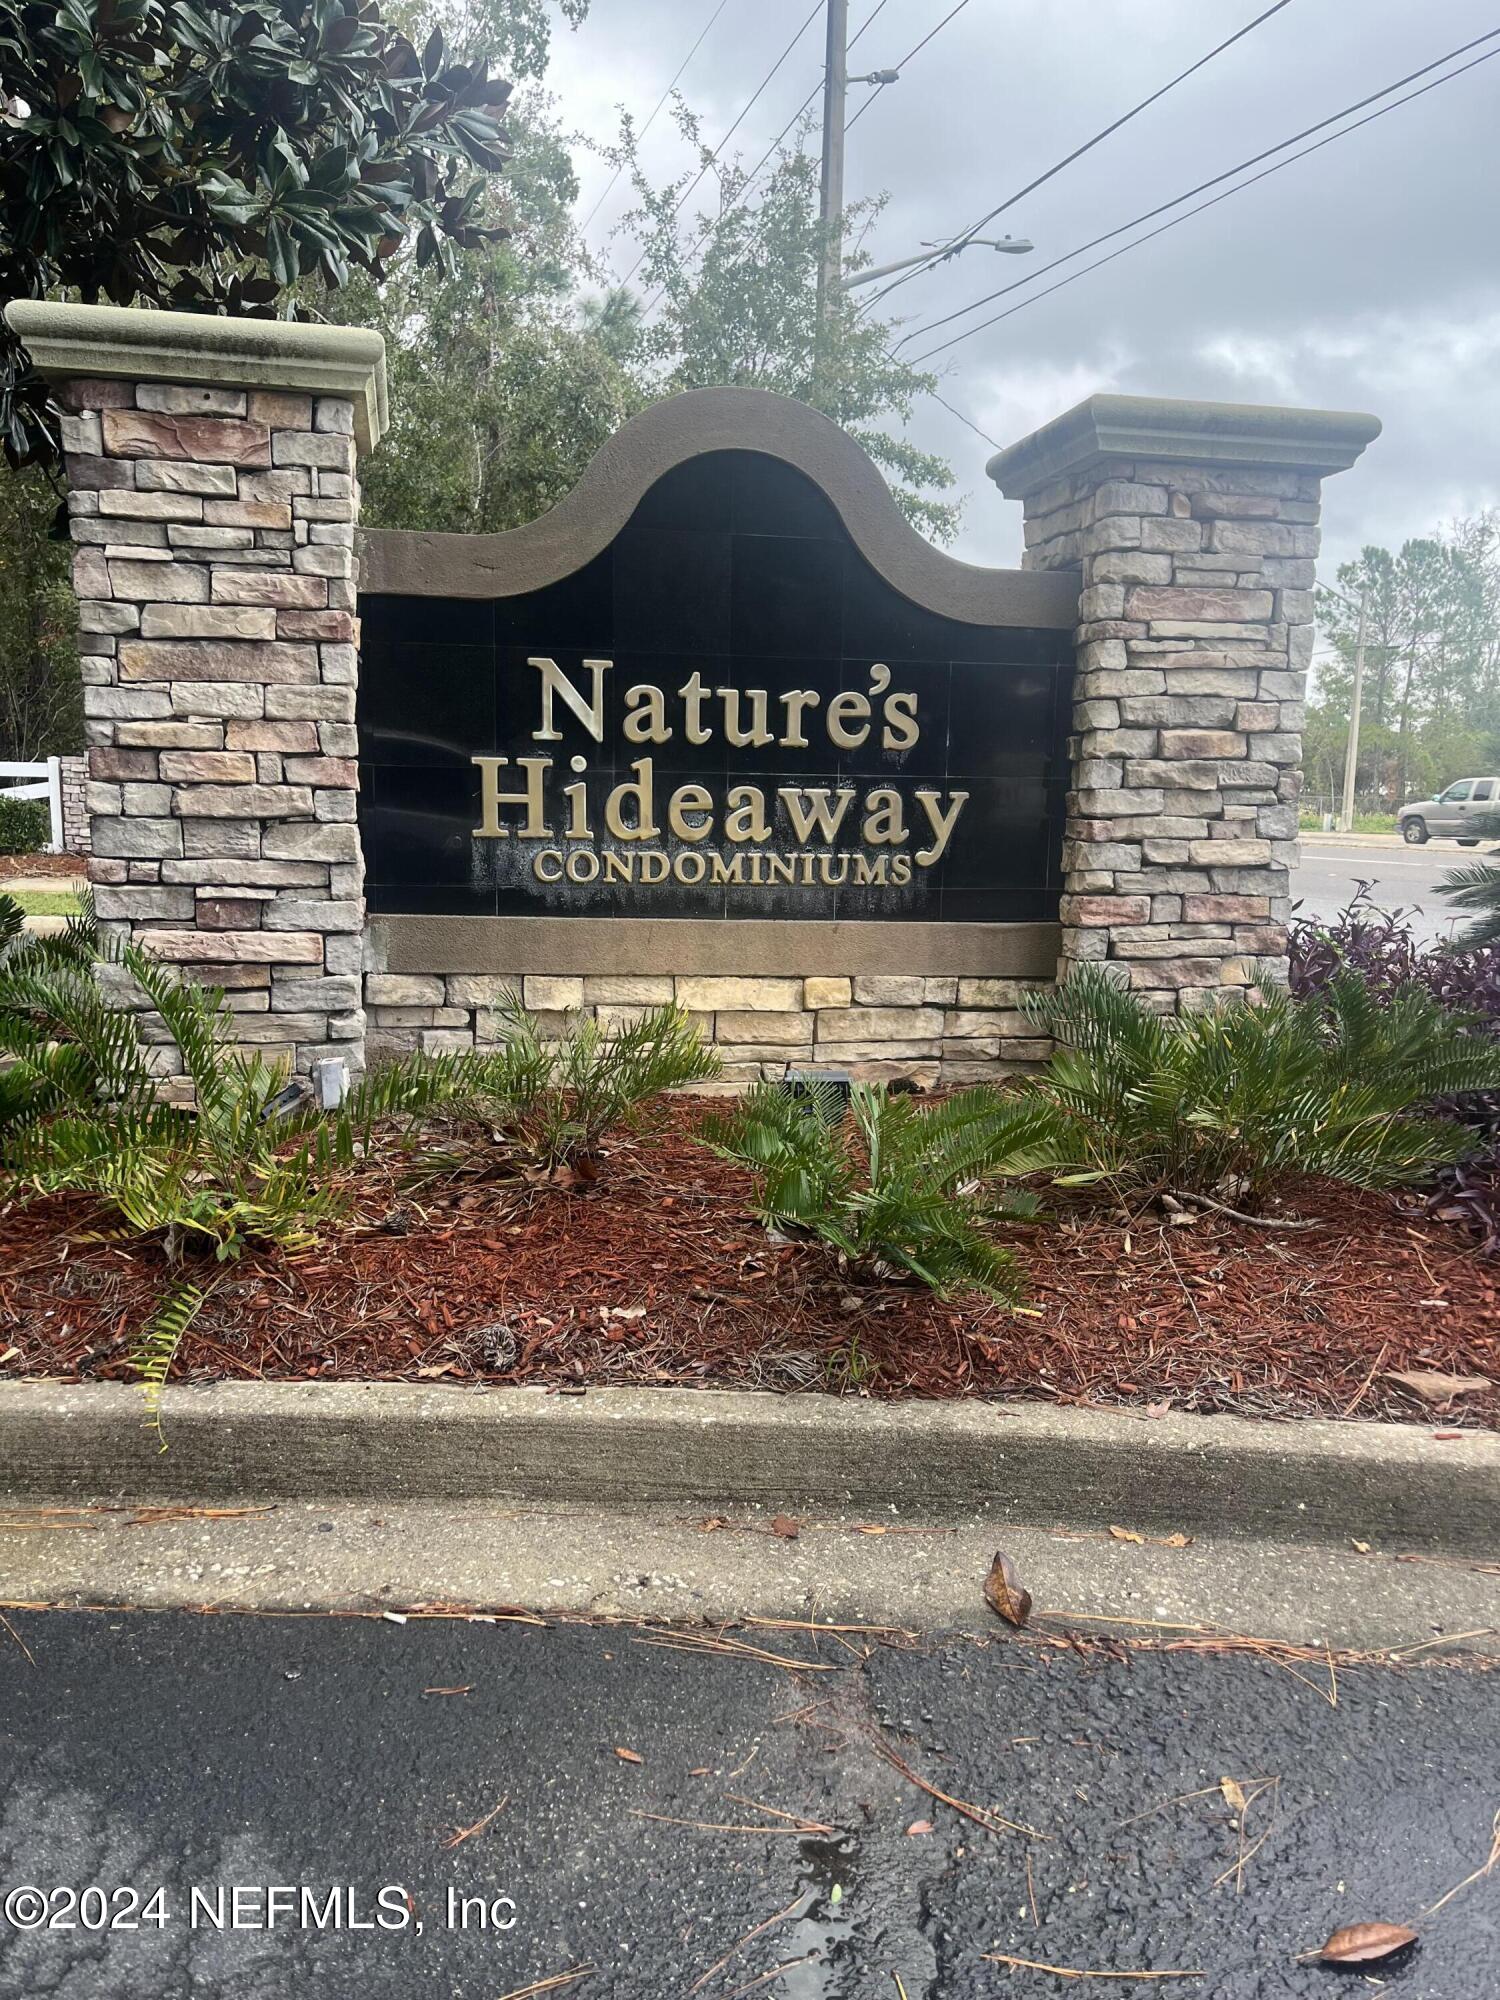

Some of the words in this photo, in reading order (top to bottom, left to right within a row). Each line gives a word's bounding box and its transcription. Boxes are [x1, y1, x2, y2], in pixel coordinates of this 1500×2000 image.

[527, 657, 920, 750] Nature's
[471, 755, 969, 866] Hideaway
[533, 849, 911, 886] CONDOMINIUMS
